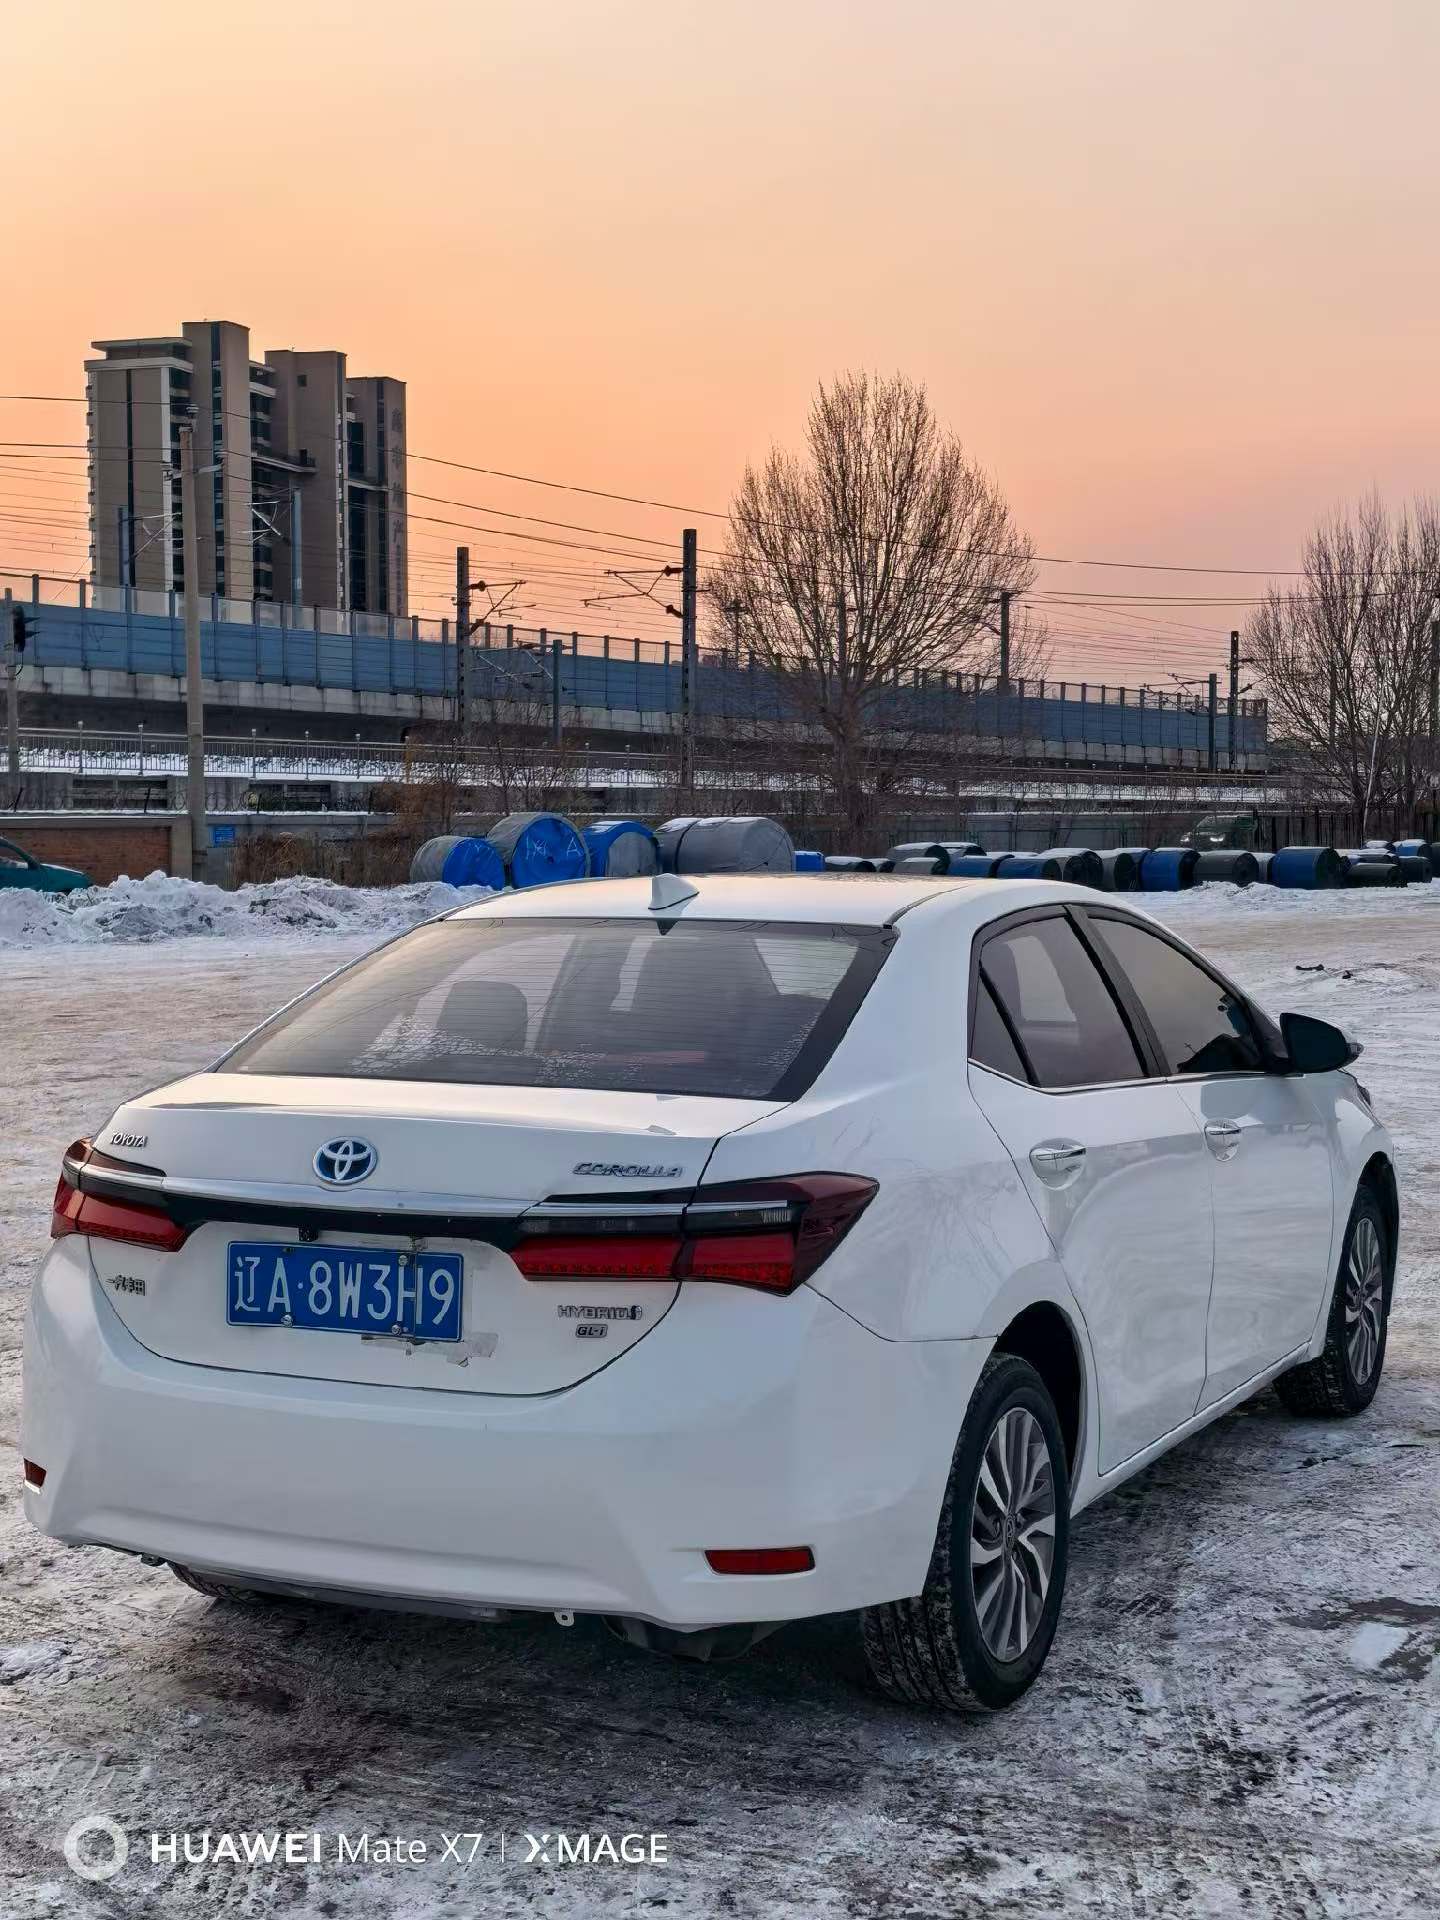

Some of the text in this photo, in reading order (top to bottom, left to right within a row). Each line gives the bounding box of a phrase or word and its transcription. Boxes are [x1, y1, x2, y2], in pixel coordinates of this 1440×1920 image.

[111, 1131, 148, 1147] TOYOTA
[573, 1162, 683, 1177] COROLLA
[557, 1304, 630, 1320] HYBRID
